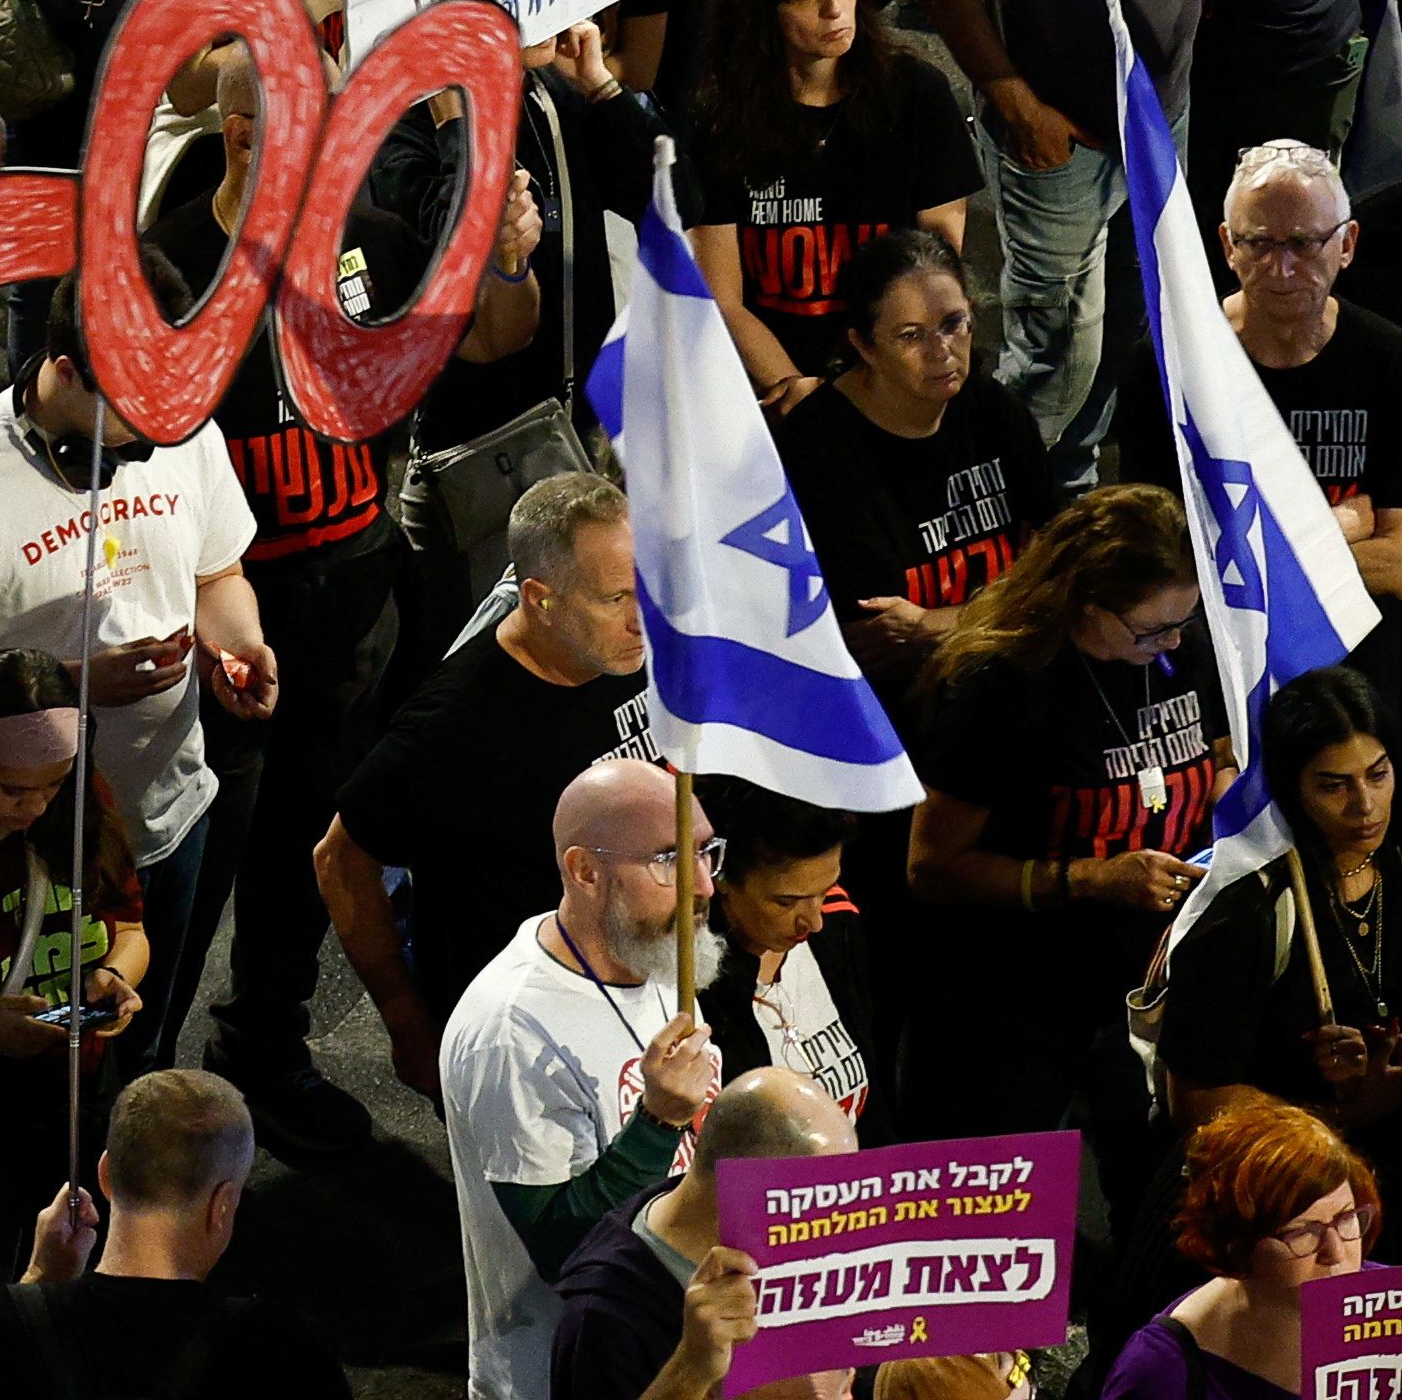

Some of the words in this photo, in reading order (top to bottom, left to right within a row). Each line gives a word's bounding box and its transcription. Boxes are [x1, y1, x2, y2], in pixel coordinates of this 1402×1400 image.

[750, 200, 779, 226] HEM
[782, 197, 824, 223] HOME
[742, 224, 892, 300] NOW
[1290, 409, 1369, 443] מחזירים
[1315, 444, 1367, 478] אותם
[21, 493, 180, 566] DEMOCRACY
[1137, 690, 1203, 740] מחזירים
[891, 1171, 943, 1197] את
[949, 1156, 1034, 1190] לקבל
[766, 1177, 883, 1220] העסקה
[895, 1200, 941, 1224] את
[950, 1188, 1032, 1216] לעצור
[767, 1206, 889, 1247] המלחמה
[903, 1245, 1046, 1295] לצאת
